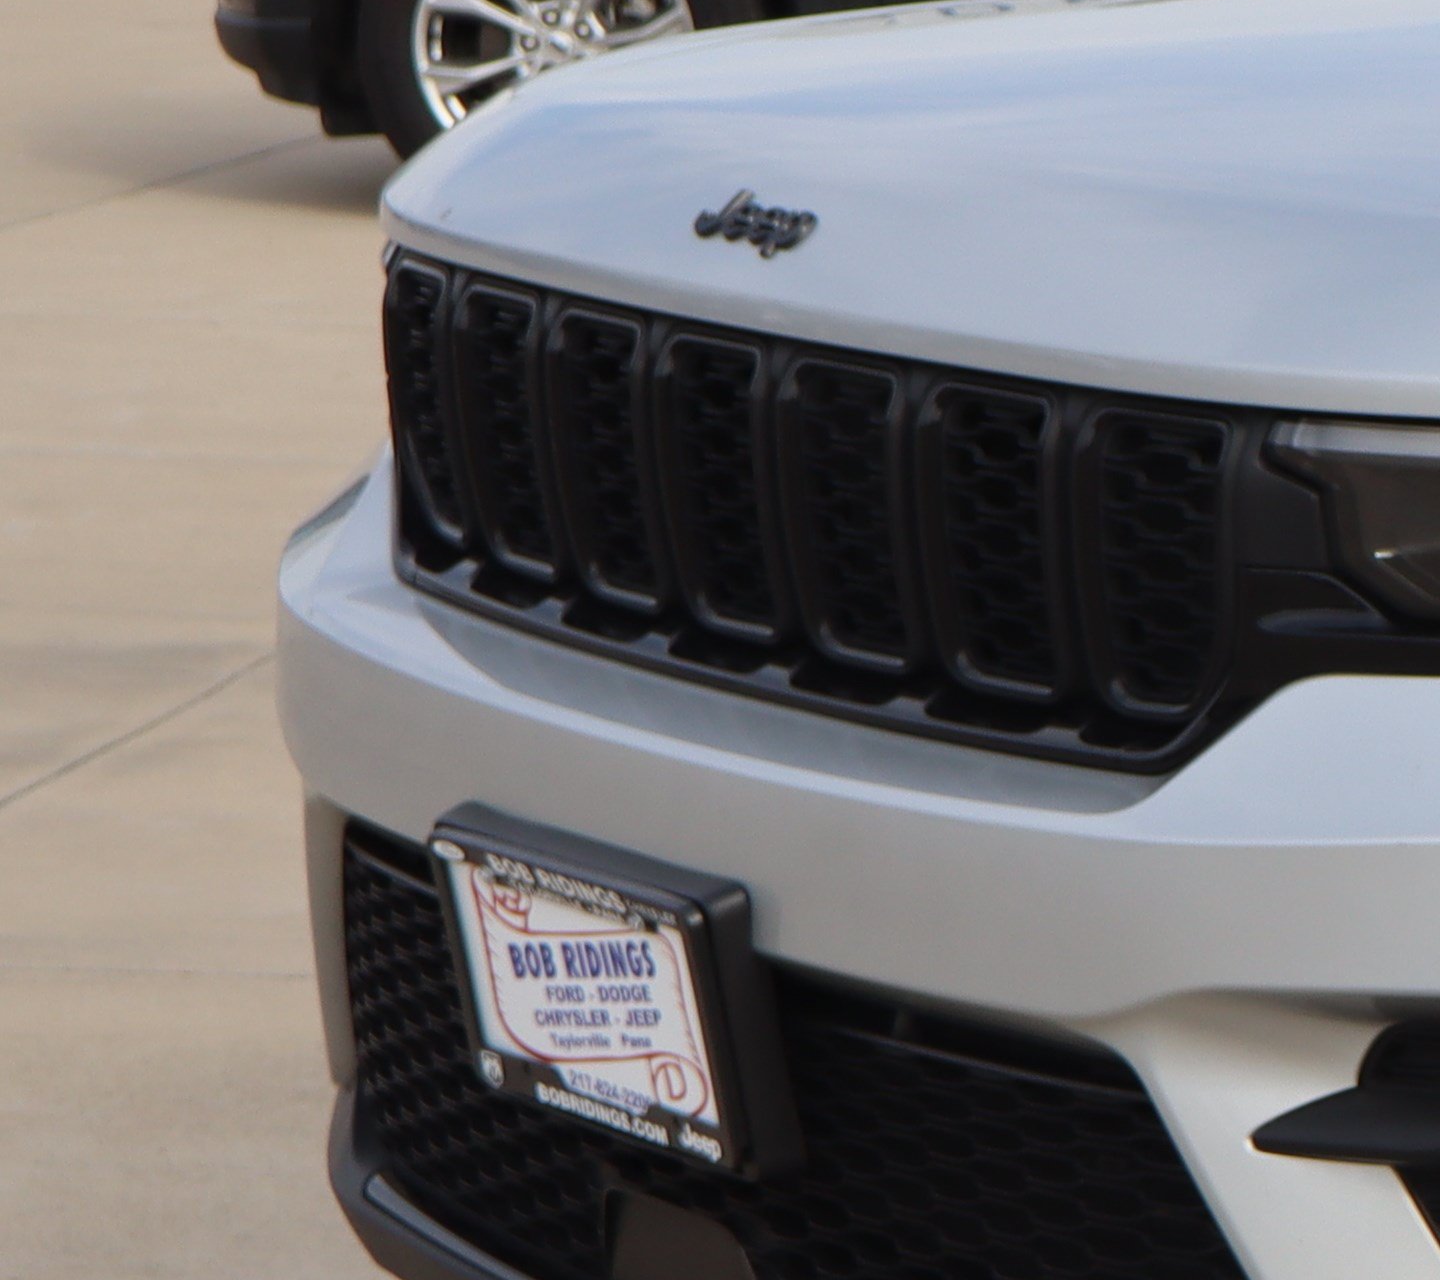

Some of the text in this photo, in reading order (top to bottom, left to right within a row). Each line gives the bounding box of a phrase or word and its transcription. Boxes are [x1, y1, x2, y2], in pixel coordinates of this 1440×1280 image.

[694, 188, 818, 258] Jeep
[507, 939, 656, 979] BOB RIDINGS
[546, 984, 586, 1002] FORD
[598, 984, 652, 1002] DODGE
[534, 1008, 610, 1027] CHRYSLER
[625, 1008, 662, 1027] JEEP
[679, 1123, 722, 1163] Jeep
